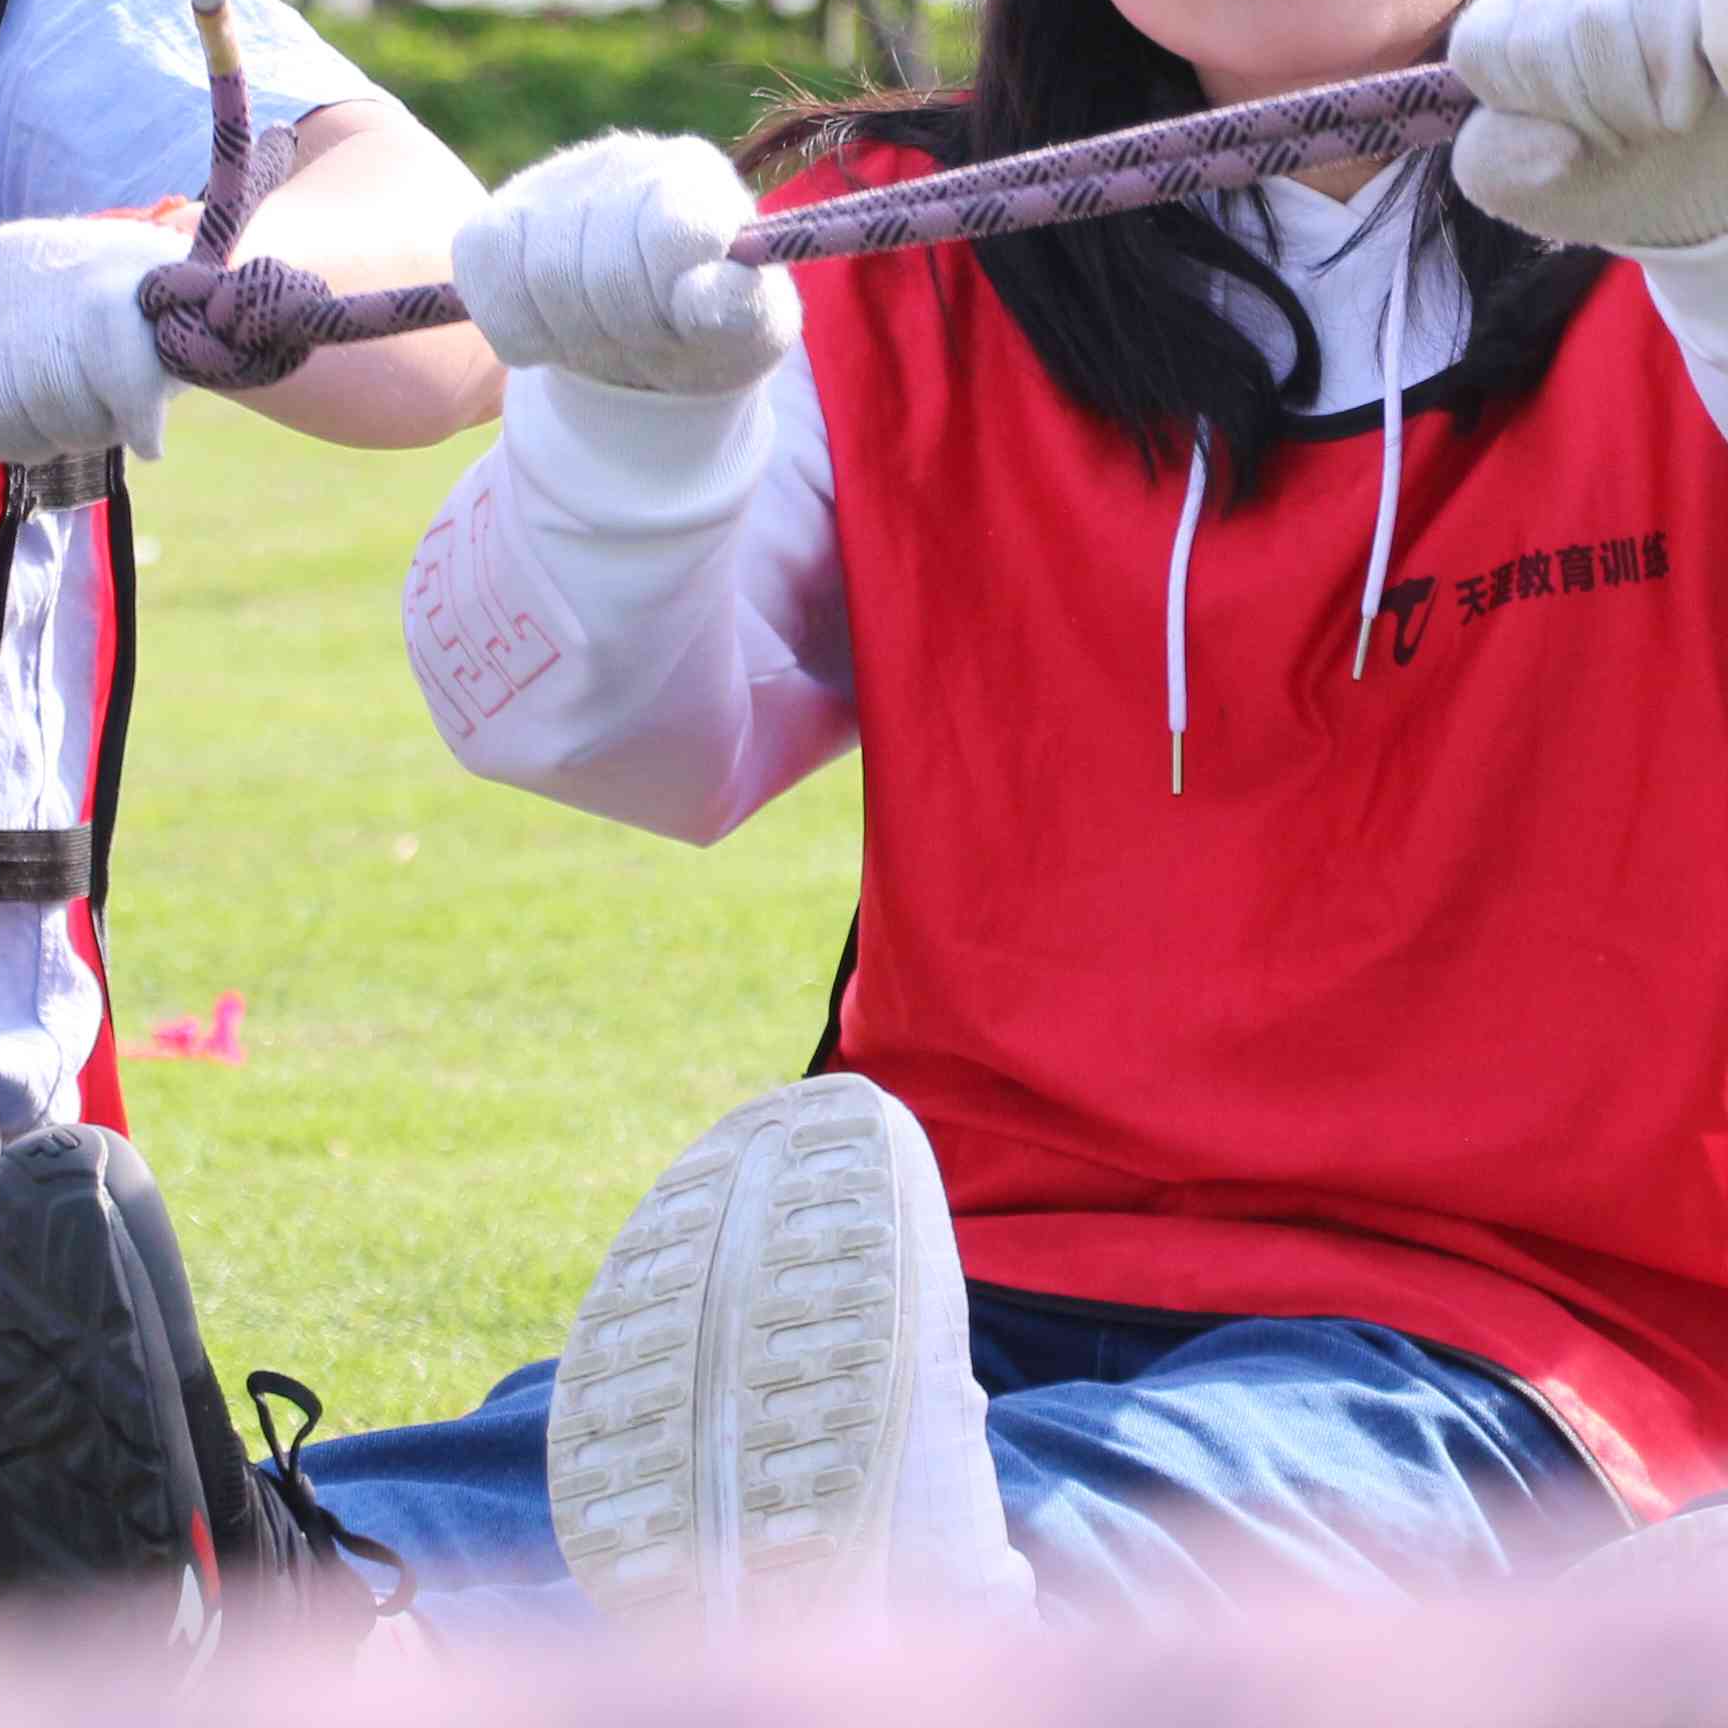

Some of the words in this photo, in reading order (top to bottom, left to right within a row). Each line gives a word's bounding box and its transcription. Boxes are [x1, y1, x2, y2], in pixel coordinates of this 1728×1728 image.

[1455, 530, 1670, 625] 天涯教育训练
